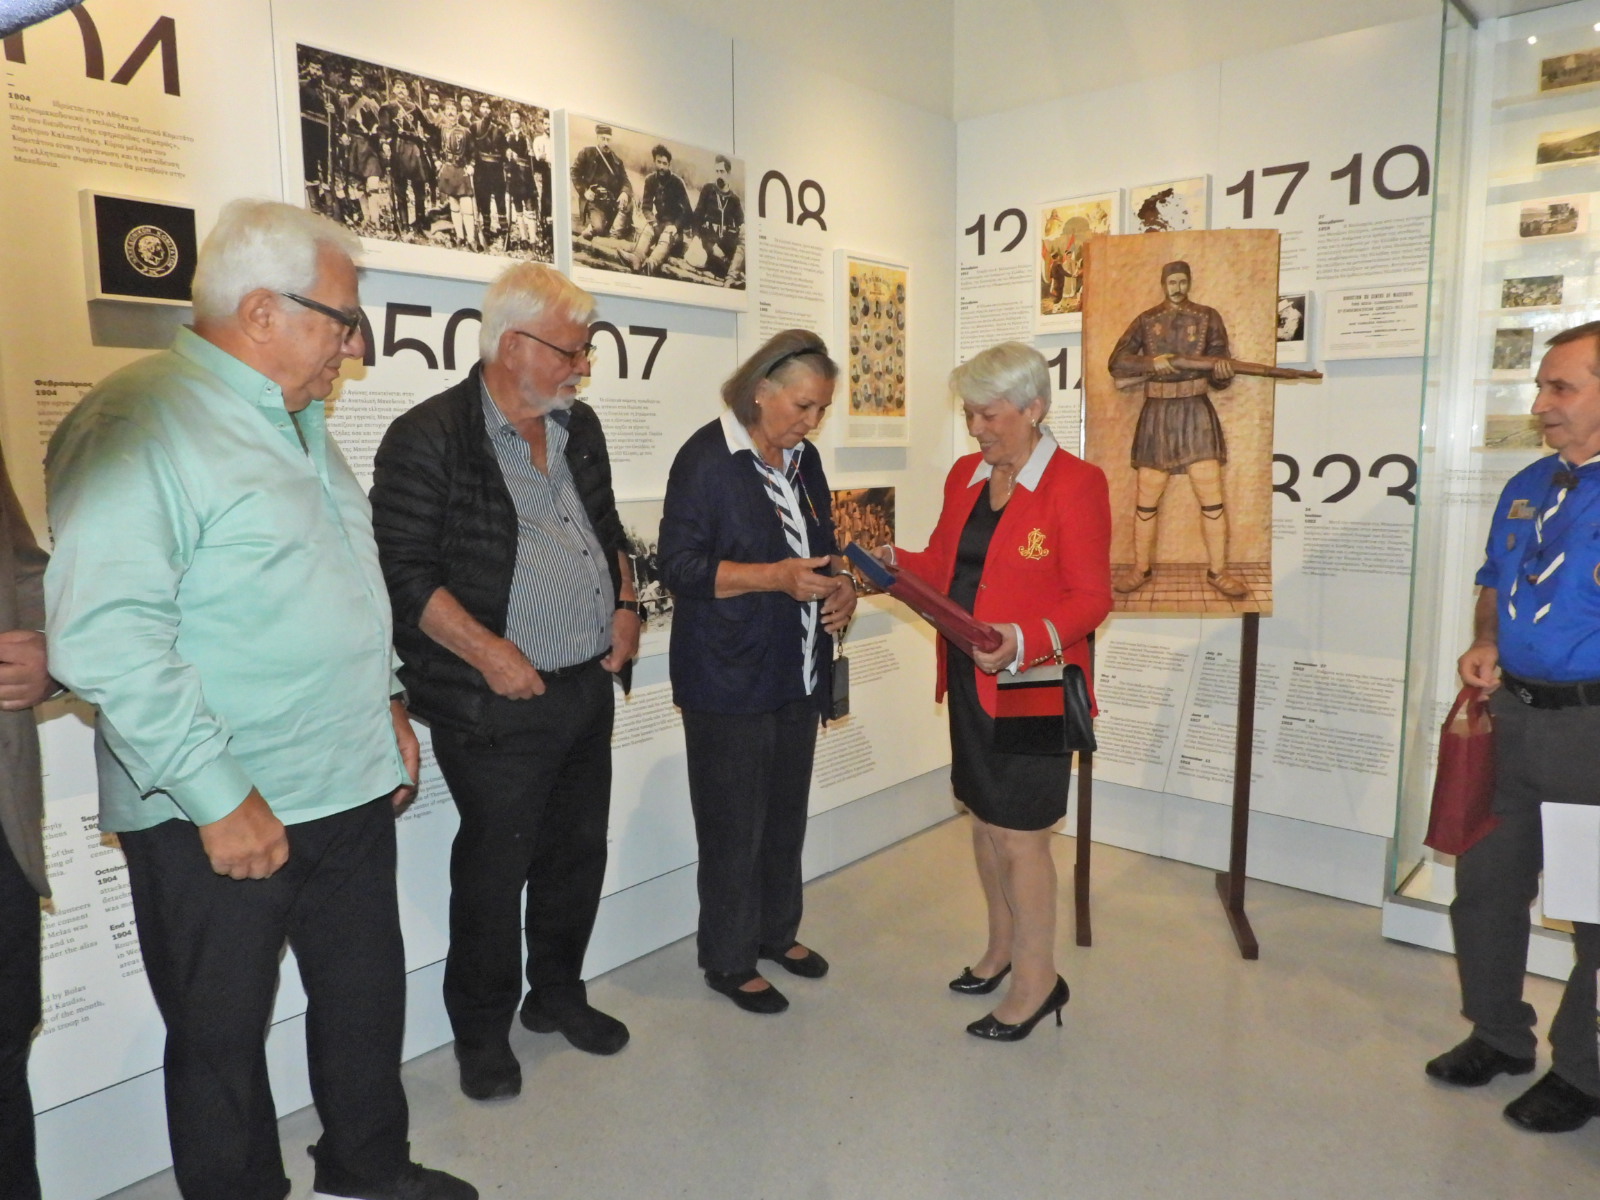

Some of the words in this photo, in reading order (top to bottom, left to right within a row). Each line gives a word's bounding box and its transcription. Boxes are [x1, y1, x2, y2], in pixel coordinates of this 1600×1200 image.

[8, 92, 31, 102] 1904
[1226, 161, 1310, 220] 17
[965, 208, 1028, 256] 12
[1313, 453, 1418, 506] 23
[97, 875, 118, 886] 1904
[109, 922, 125, 932] End
[111, 929, 132, 941] 1904
